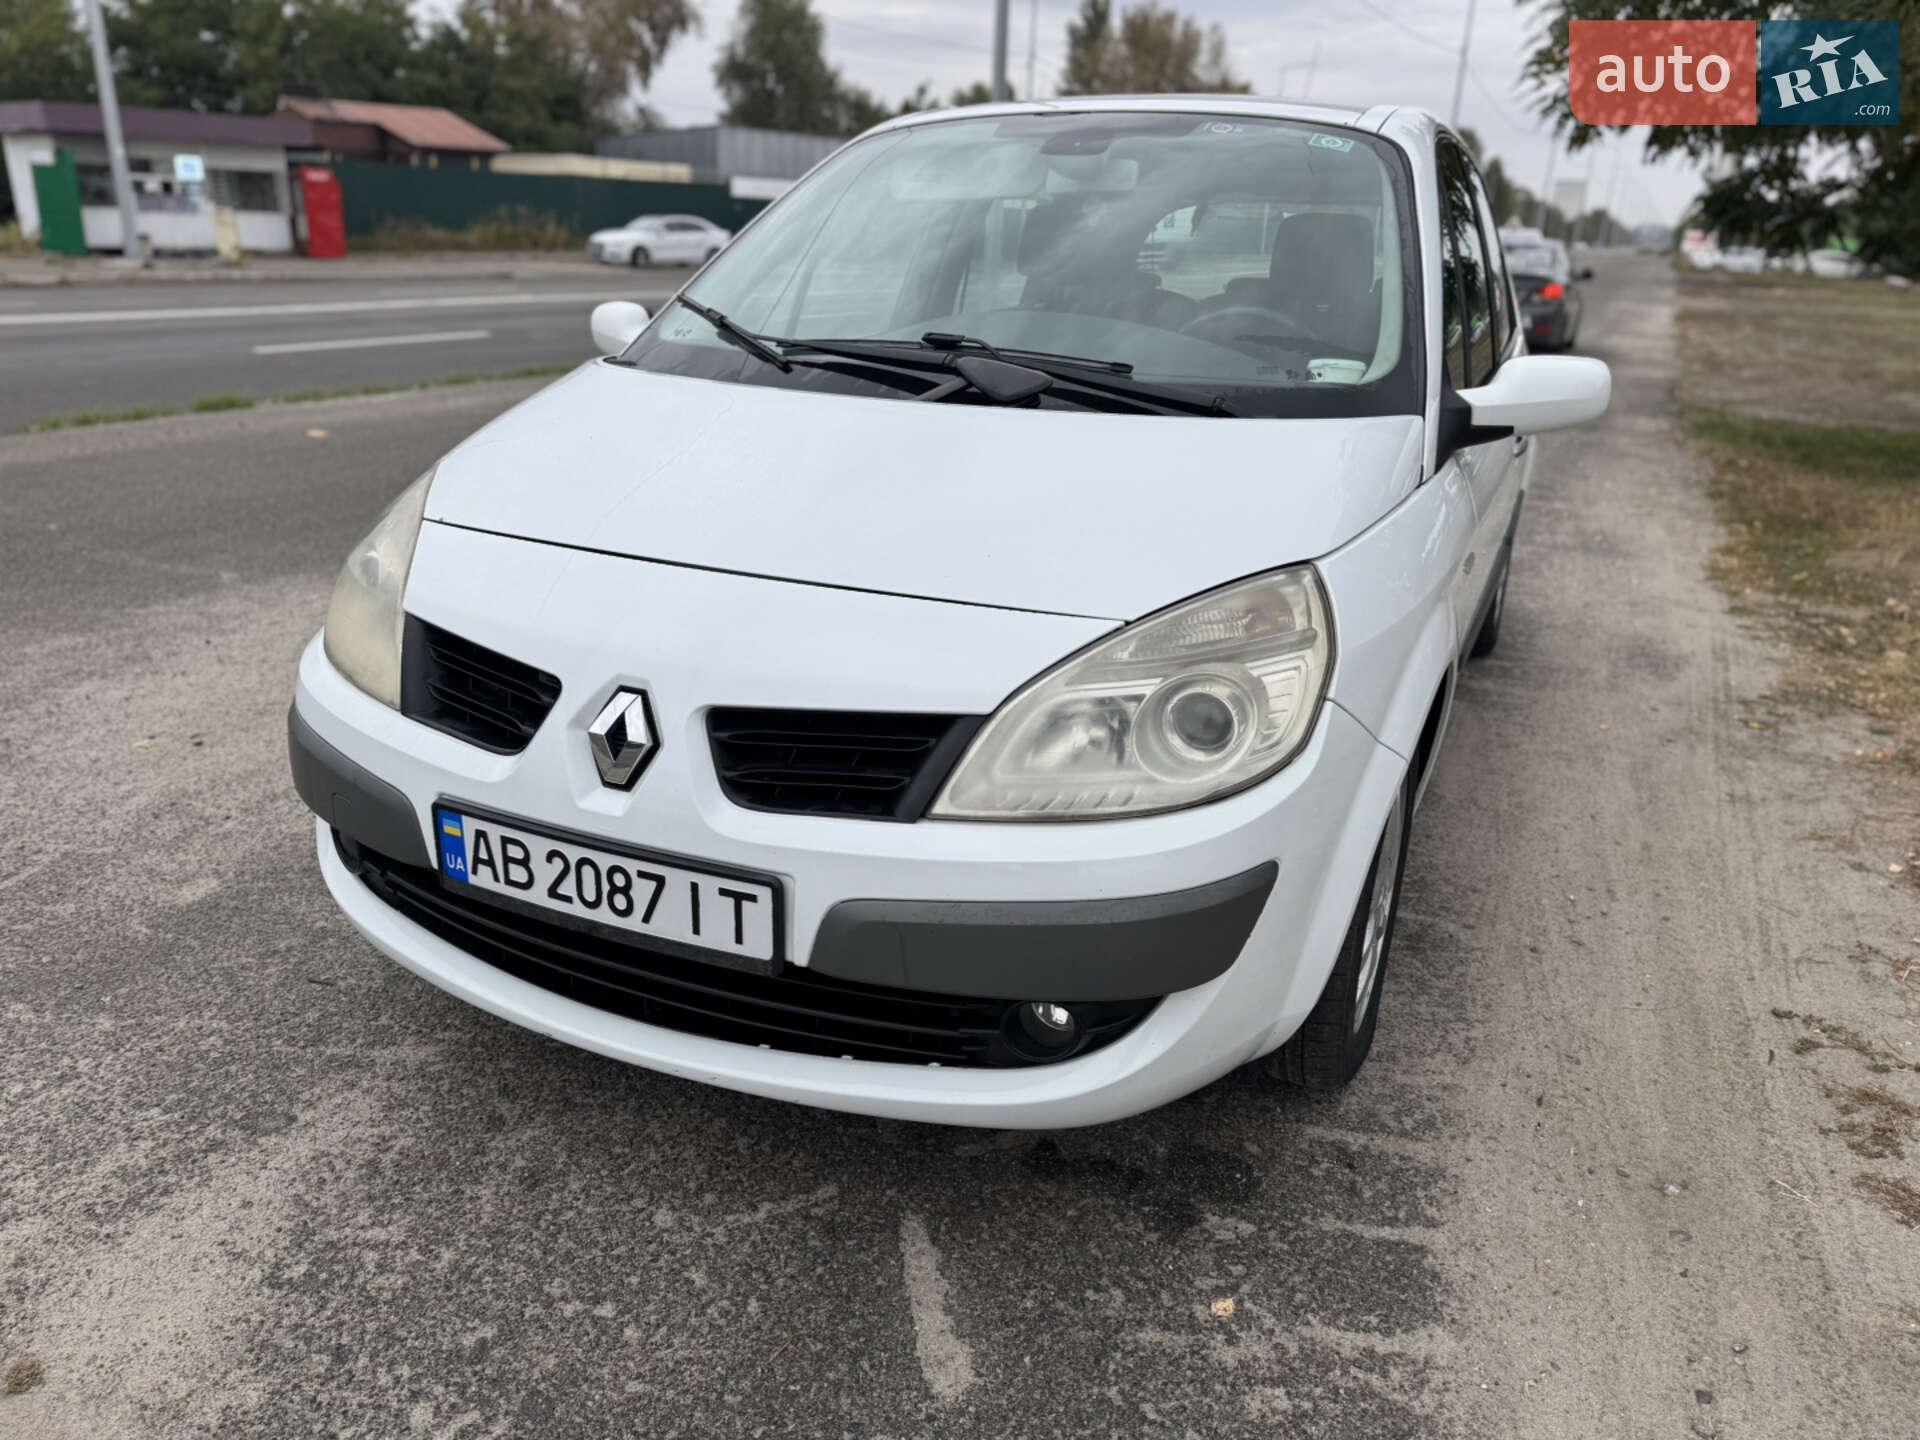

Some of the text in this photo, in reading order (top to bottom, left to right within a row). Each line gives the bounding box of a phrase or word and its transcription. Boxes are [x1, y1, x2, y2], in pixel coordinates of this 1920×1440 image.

[446, 853, 466, 873] UA
[471, 829, 758, 945] AB 2087 IT
